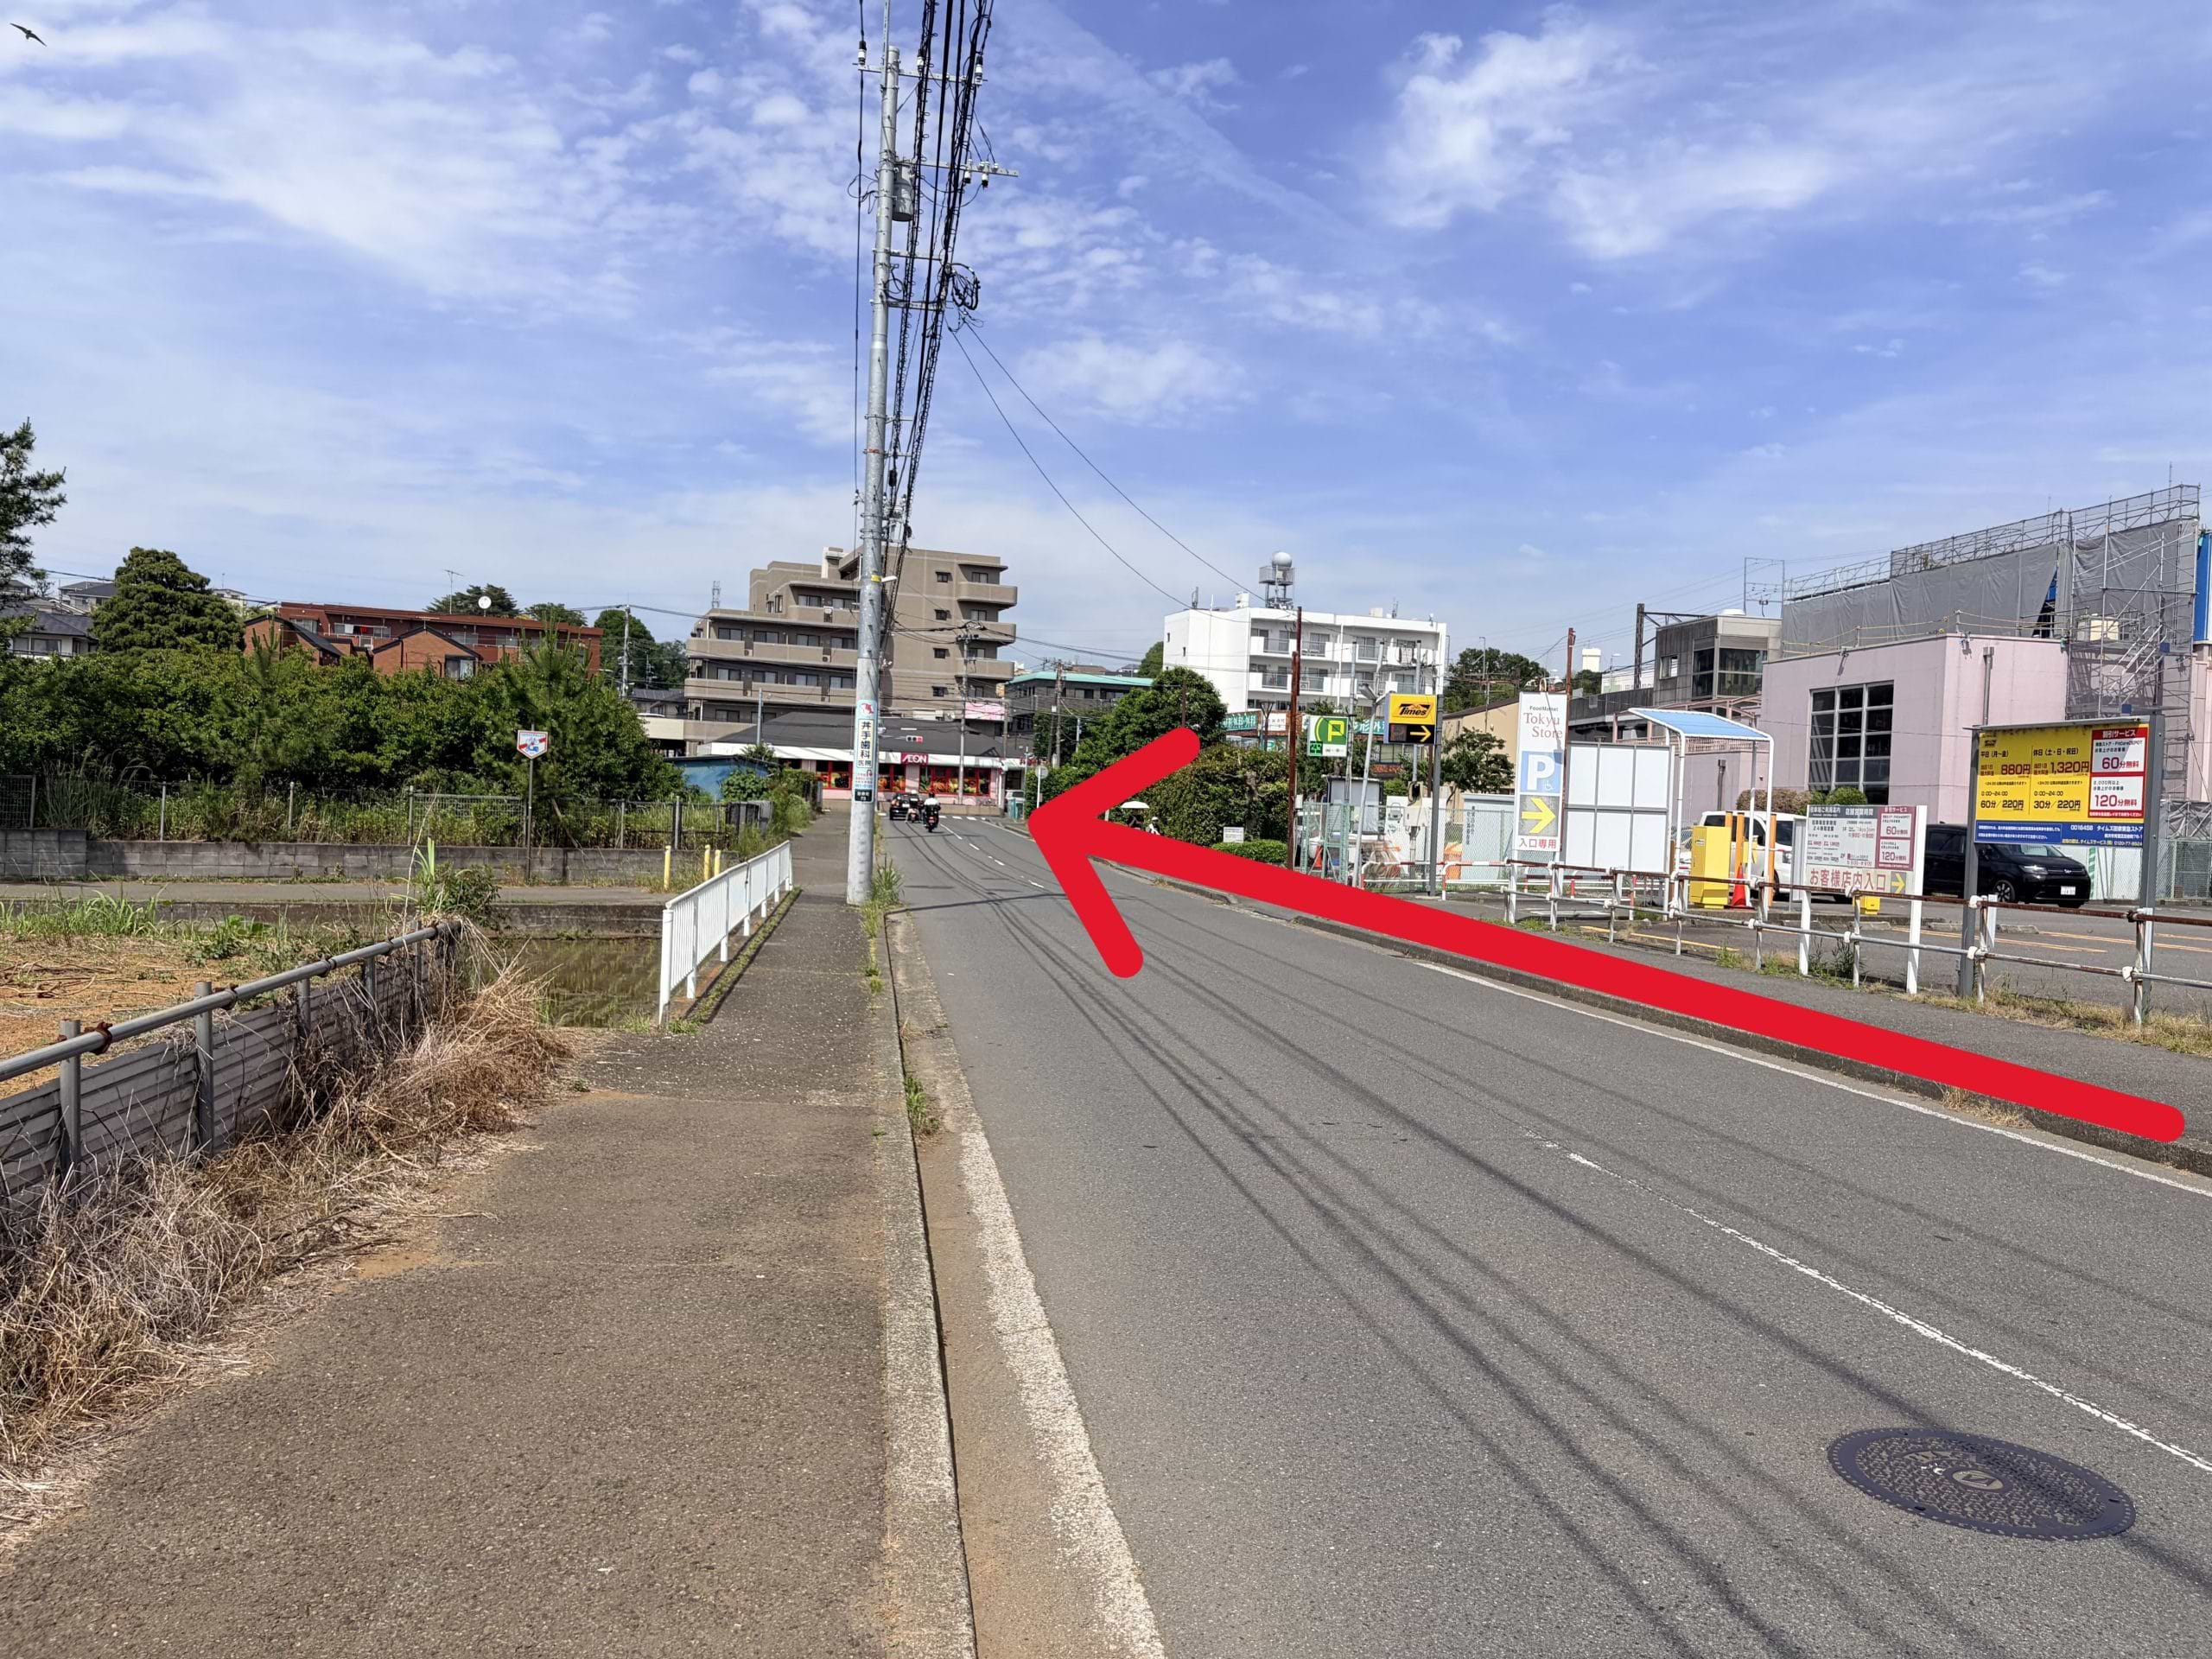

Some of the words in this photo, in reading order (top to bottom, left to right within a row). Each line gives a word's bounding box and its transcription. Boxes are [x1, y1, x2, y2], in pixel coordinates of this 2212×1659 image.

[1399, 703, 1431, 715] Times
[1523, 713, 1560, 727] Tokyu
[1328, 721, 1344, 741] P
[1532, 726, 1563, 739] Store
[2001, 764, 2031, 775] 880円
[2050, 761, 2089, 774] 1,320円
[2102, 757, 2139, 769] 60分無料
[1527, 754, 1556, 791] P
[2094, 795, 2138, 807] 120分無料
[1519, 838, 1557, 849] 入口専用
[1810, 868, 1886, 892] お客様店内入口
